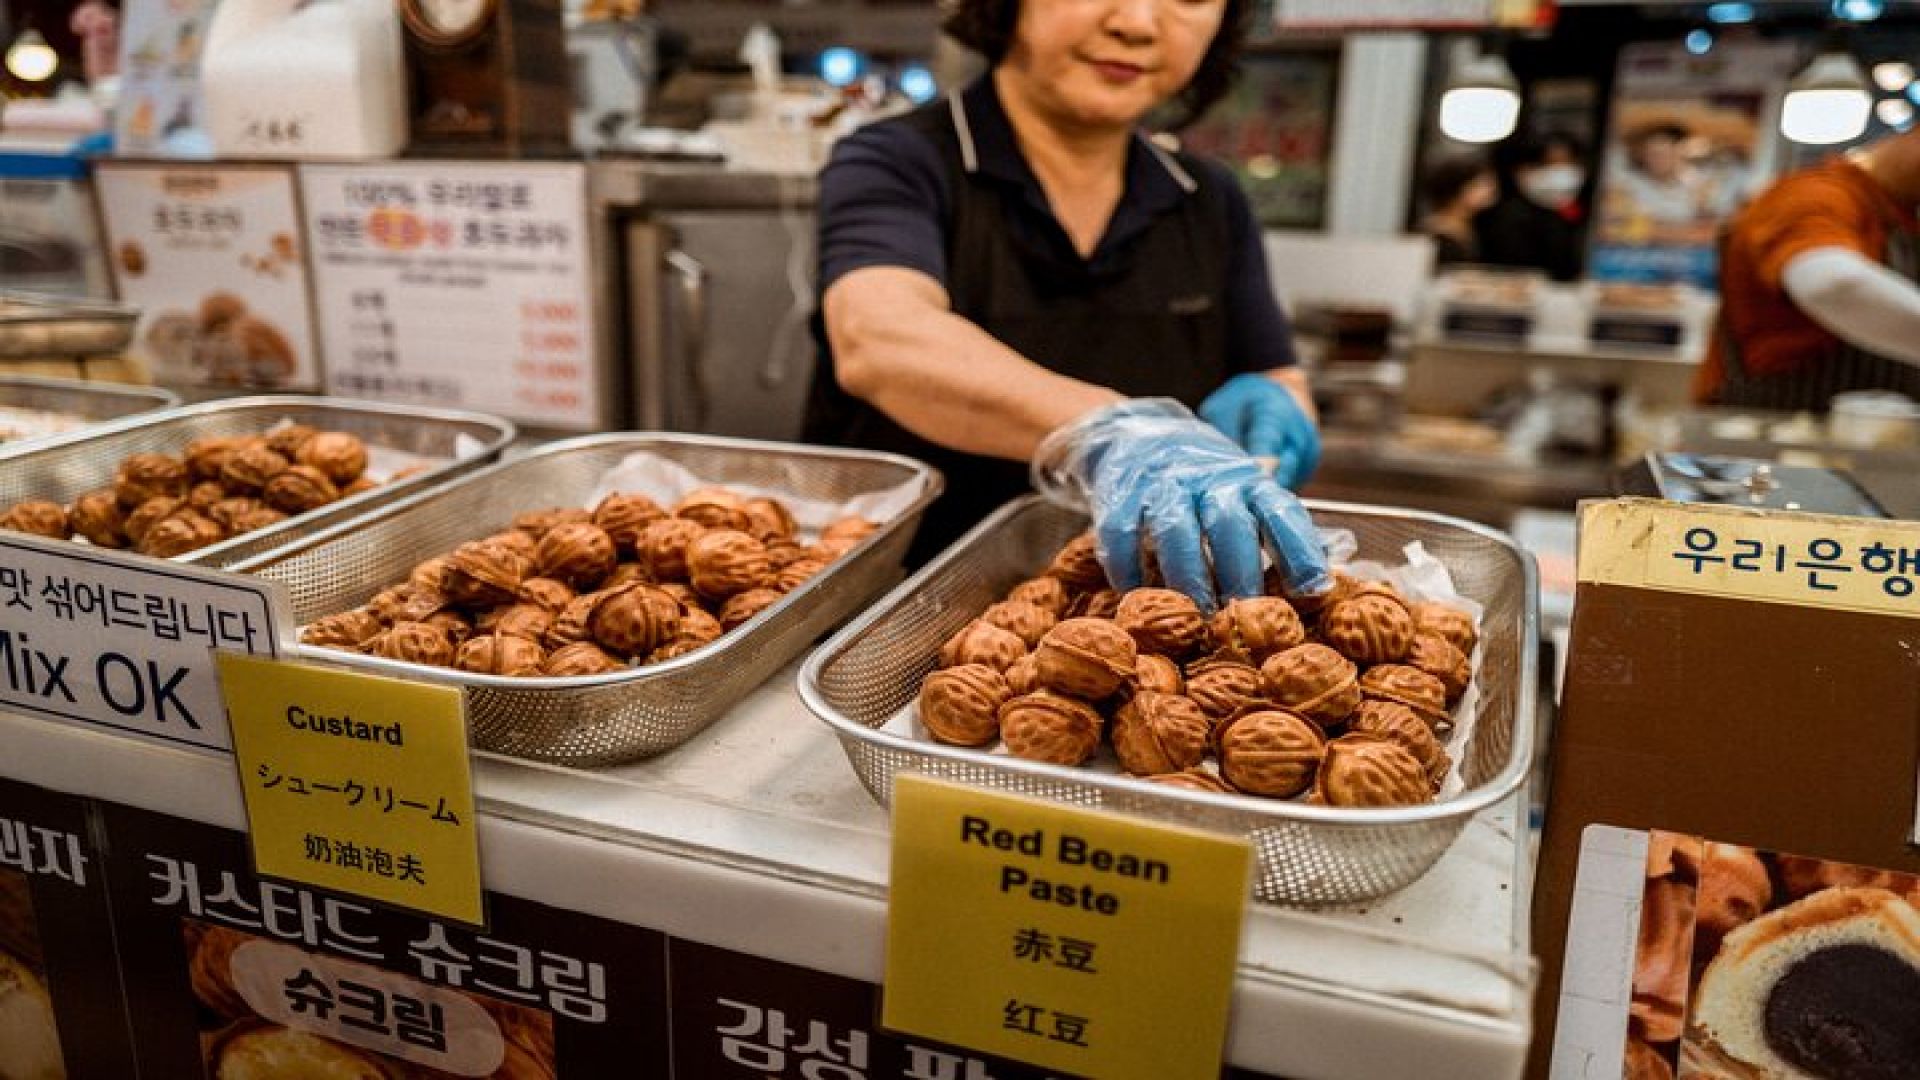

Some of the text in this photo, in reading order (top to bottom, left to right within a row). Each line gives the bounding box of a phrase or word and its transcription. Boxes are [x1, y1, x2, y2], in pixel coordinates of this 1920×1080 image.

[1672, 527, 1920, 597] 우리은행
[0, 567, 257, 656] 맛 섞어드립니다
[96, 652, 201, 730] OK
[286, 705, 404, 746] Custard
[257, 763, 460, 826] シュークリーム
[304, 832, 426, 886] 奶油泡夫
[960, 814, 1170, 885] Red Bean
[1001, 865, 1121, 916] Paste
[145, 853, 608, 1023] 커스타드 슈크림
[1013, 928, 1098, 974] 赤豆
[284, 968, 447, 1053] 슈크림
[1002, 998, 1089, 1047] 红豆
